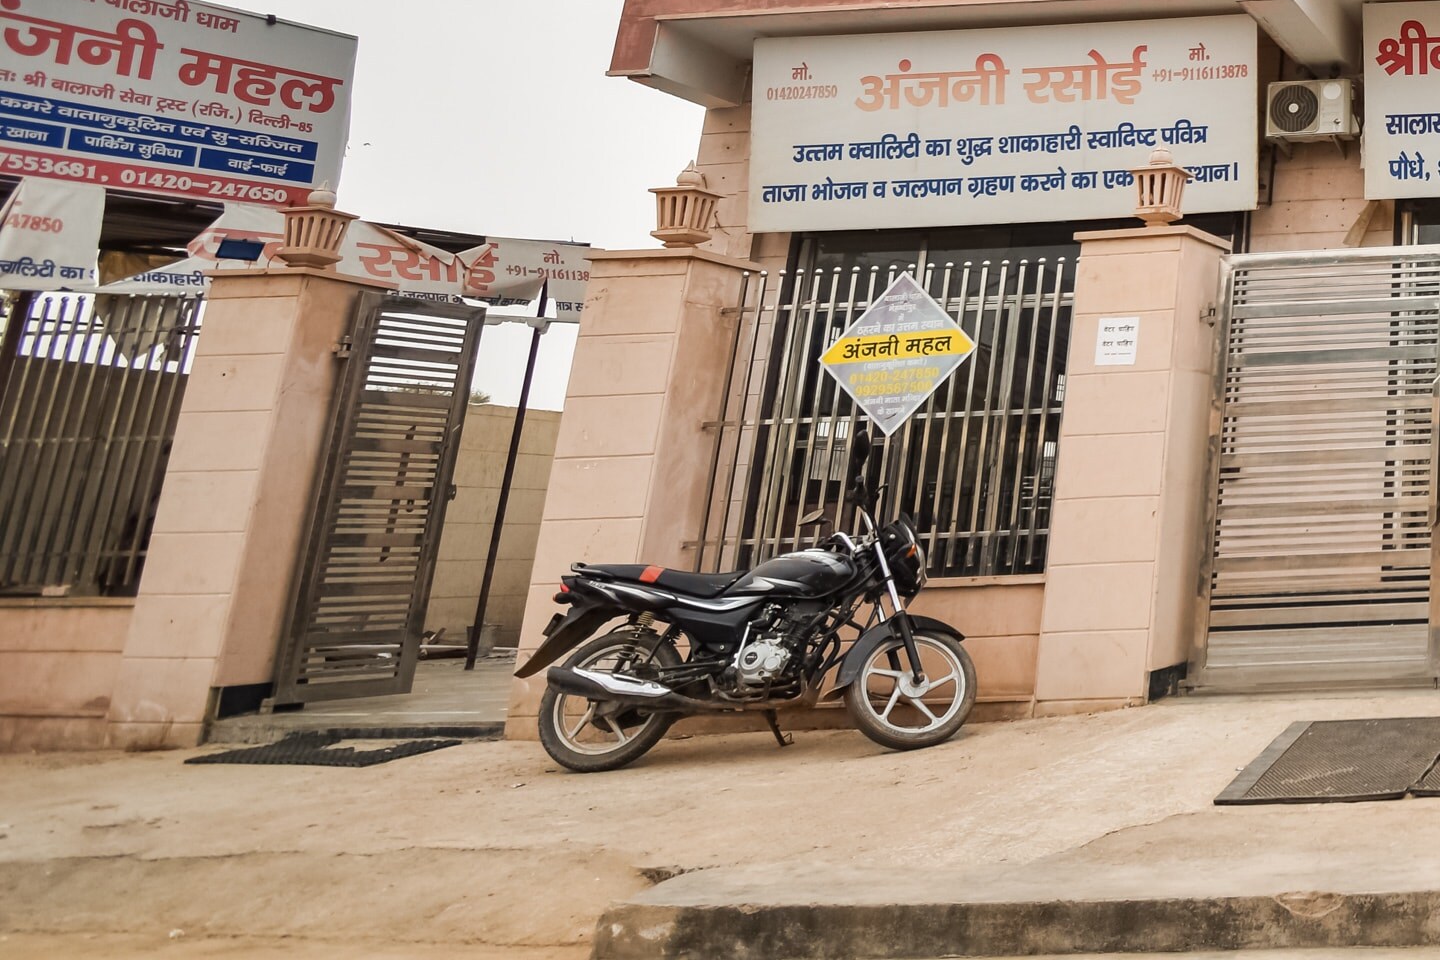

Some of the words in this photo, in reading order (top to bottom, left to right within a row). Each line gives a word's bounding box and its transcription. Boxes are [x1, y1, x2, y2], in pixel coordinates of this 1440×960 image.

[196, 13, 240, 33] धाम
[1189, 43, 1210, 62] मो.
[179, 47, 344, 114] महल
[792, 62, 813, 81] मो.
[854, 53, 1010, 112] अंजनी
[1022, 44, 1147, 105] रसोई
[1152, 64, 1248, 83] +91-9116113878
[23, 70, 47, 88] श्री
[120, 88, 153, 106] सेवा
[156, 96, 187, 114] ट्रस्ट
[192, 99, 242, 125] (रजि.)
[248, 109, 313, 133] दिल्ली-85
[767, 85, 838, 101] 01420247850
[0, 95, 55, 114] कमरे
[58, 105, 177, 133] वातानुकूलित
[180, 125, 210, 138] एवं
[6, 126, 49, 142] खाना
[792, 143, 844, 163] उत्तम
[849, 132, 921, 160] क्वालिटी
[925, 138, 952, 157] का
[956, 136, 994, 166] शुद्ध
[998, 124, 1082, 154] शाकाहारी
[1087, 122, 1157, 150] स्वादिष्ट
[1161, 119, 1209, 145] पवित्र
[84, 135, 136, 152] पार्किंग
[138, 143, 183, 159] सुविधा
[228, 157, 288, 176] वाई-फाई
[1388, 150, 1431, 182] पौधे,
[121, 168, 288, 203] 01420-247650
[762, 184, 807, 203] ताजा
[812, 176, 868, 202] भोजन
[873, 181, 887, 199] व
[891, 178, 963, 198] जलपान
[967, 174, 1016, 198] ग्रहण
[1020, 166, 1067, 193] करने
[1071, 170, 1098, 190] का
[1103, 169, 1134, 190] एक
[60, 266, 86, 280] का
[843, 334, 899, 359] अंजनी
[905, 336, 952, 355] महल
